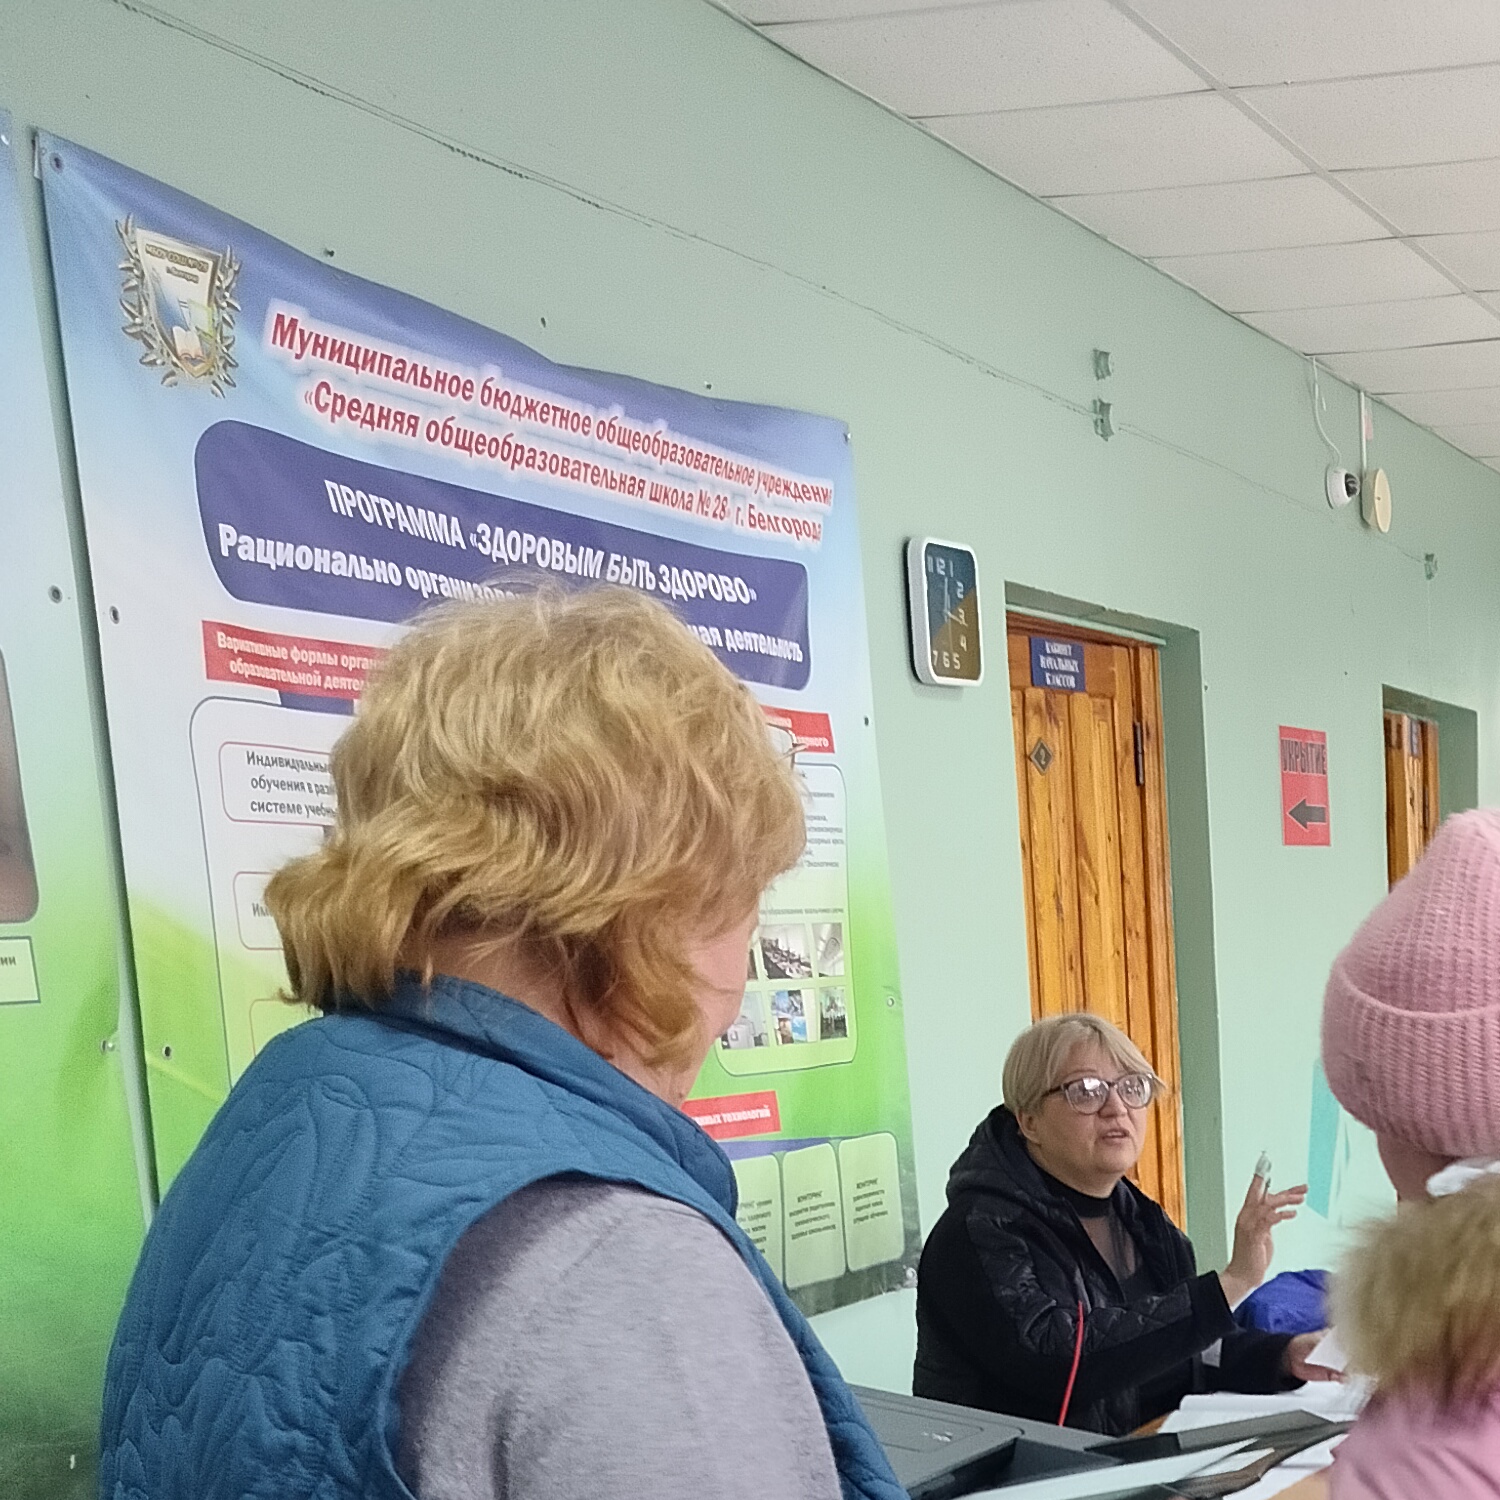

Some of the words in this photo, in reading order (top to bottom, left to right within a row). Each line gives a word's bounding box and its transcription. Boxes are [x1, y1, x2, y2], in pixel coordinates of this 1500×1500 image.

[271, 313, 474, 401] Муниципальное
[480, 376, 592, 436] бюджетное
[596, 416, 755, 484] общеобразовательное
[304, 380, 420, 438] «Средняя
[426, 416, 646, 499] общеобразовательная
[650, 481, 693, 511] школа
[697, 488, 711, 517] №
[736, 505, 745, 526] г.
[324, 479, 466, 550] ПРОГРАММА
[470, 522, 604, 579] «ЗДОРОВЫМ
[607, 552, 656, 590] БЫТЬ
[658, 563, 757, 605] ЗДОРОВО»
[936, 557, 946, 576] 12
[218, 522, 402, 586] Рационально
[725, 628, 803, 663] деятельность
[956, 581, 964, 599] 2
[216, 631, 288, 660] Вариативные
[290, 645, 338, 666] формы
[960, 634, 967, 651] 4
[230, 657, 322, 687] образовательной
[932, 650, 938, 667] 7
[942, 651, 950, 668] 6
[952, 652, 961, 670] 5
[1280, 739, 1327, 775] УКРЫТИЕ
[251, 775, 305, 793] обучения
[307, 781, 313, 794] в
[250, 800, 302, 815] системе
